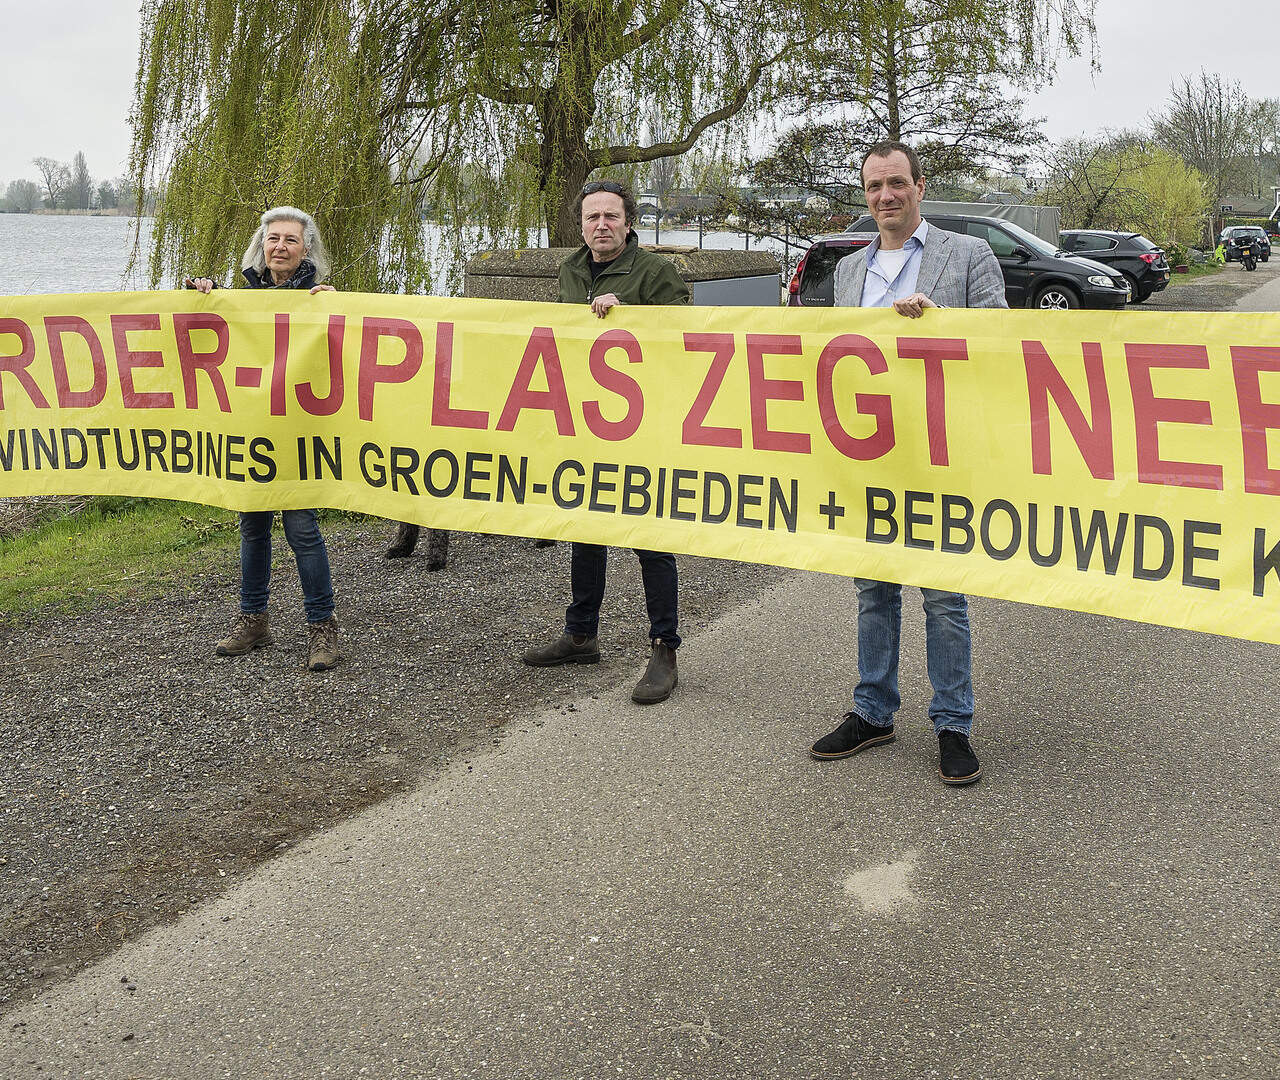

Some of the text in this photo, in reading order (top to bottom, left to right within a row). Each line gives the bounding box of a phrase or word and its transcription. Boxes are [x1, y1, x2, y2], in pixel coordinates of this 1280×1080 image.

[682, 332, 969, 466] ZEGT
[297, 436, 343, 481] IN
[360, 442, 798, 533] GROEN-GEBIEDEN
[819, 490, 845, 530] +
[865, 486, 1222, 591] BEBOUWDE
